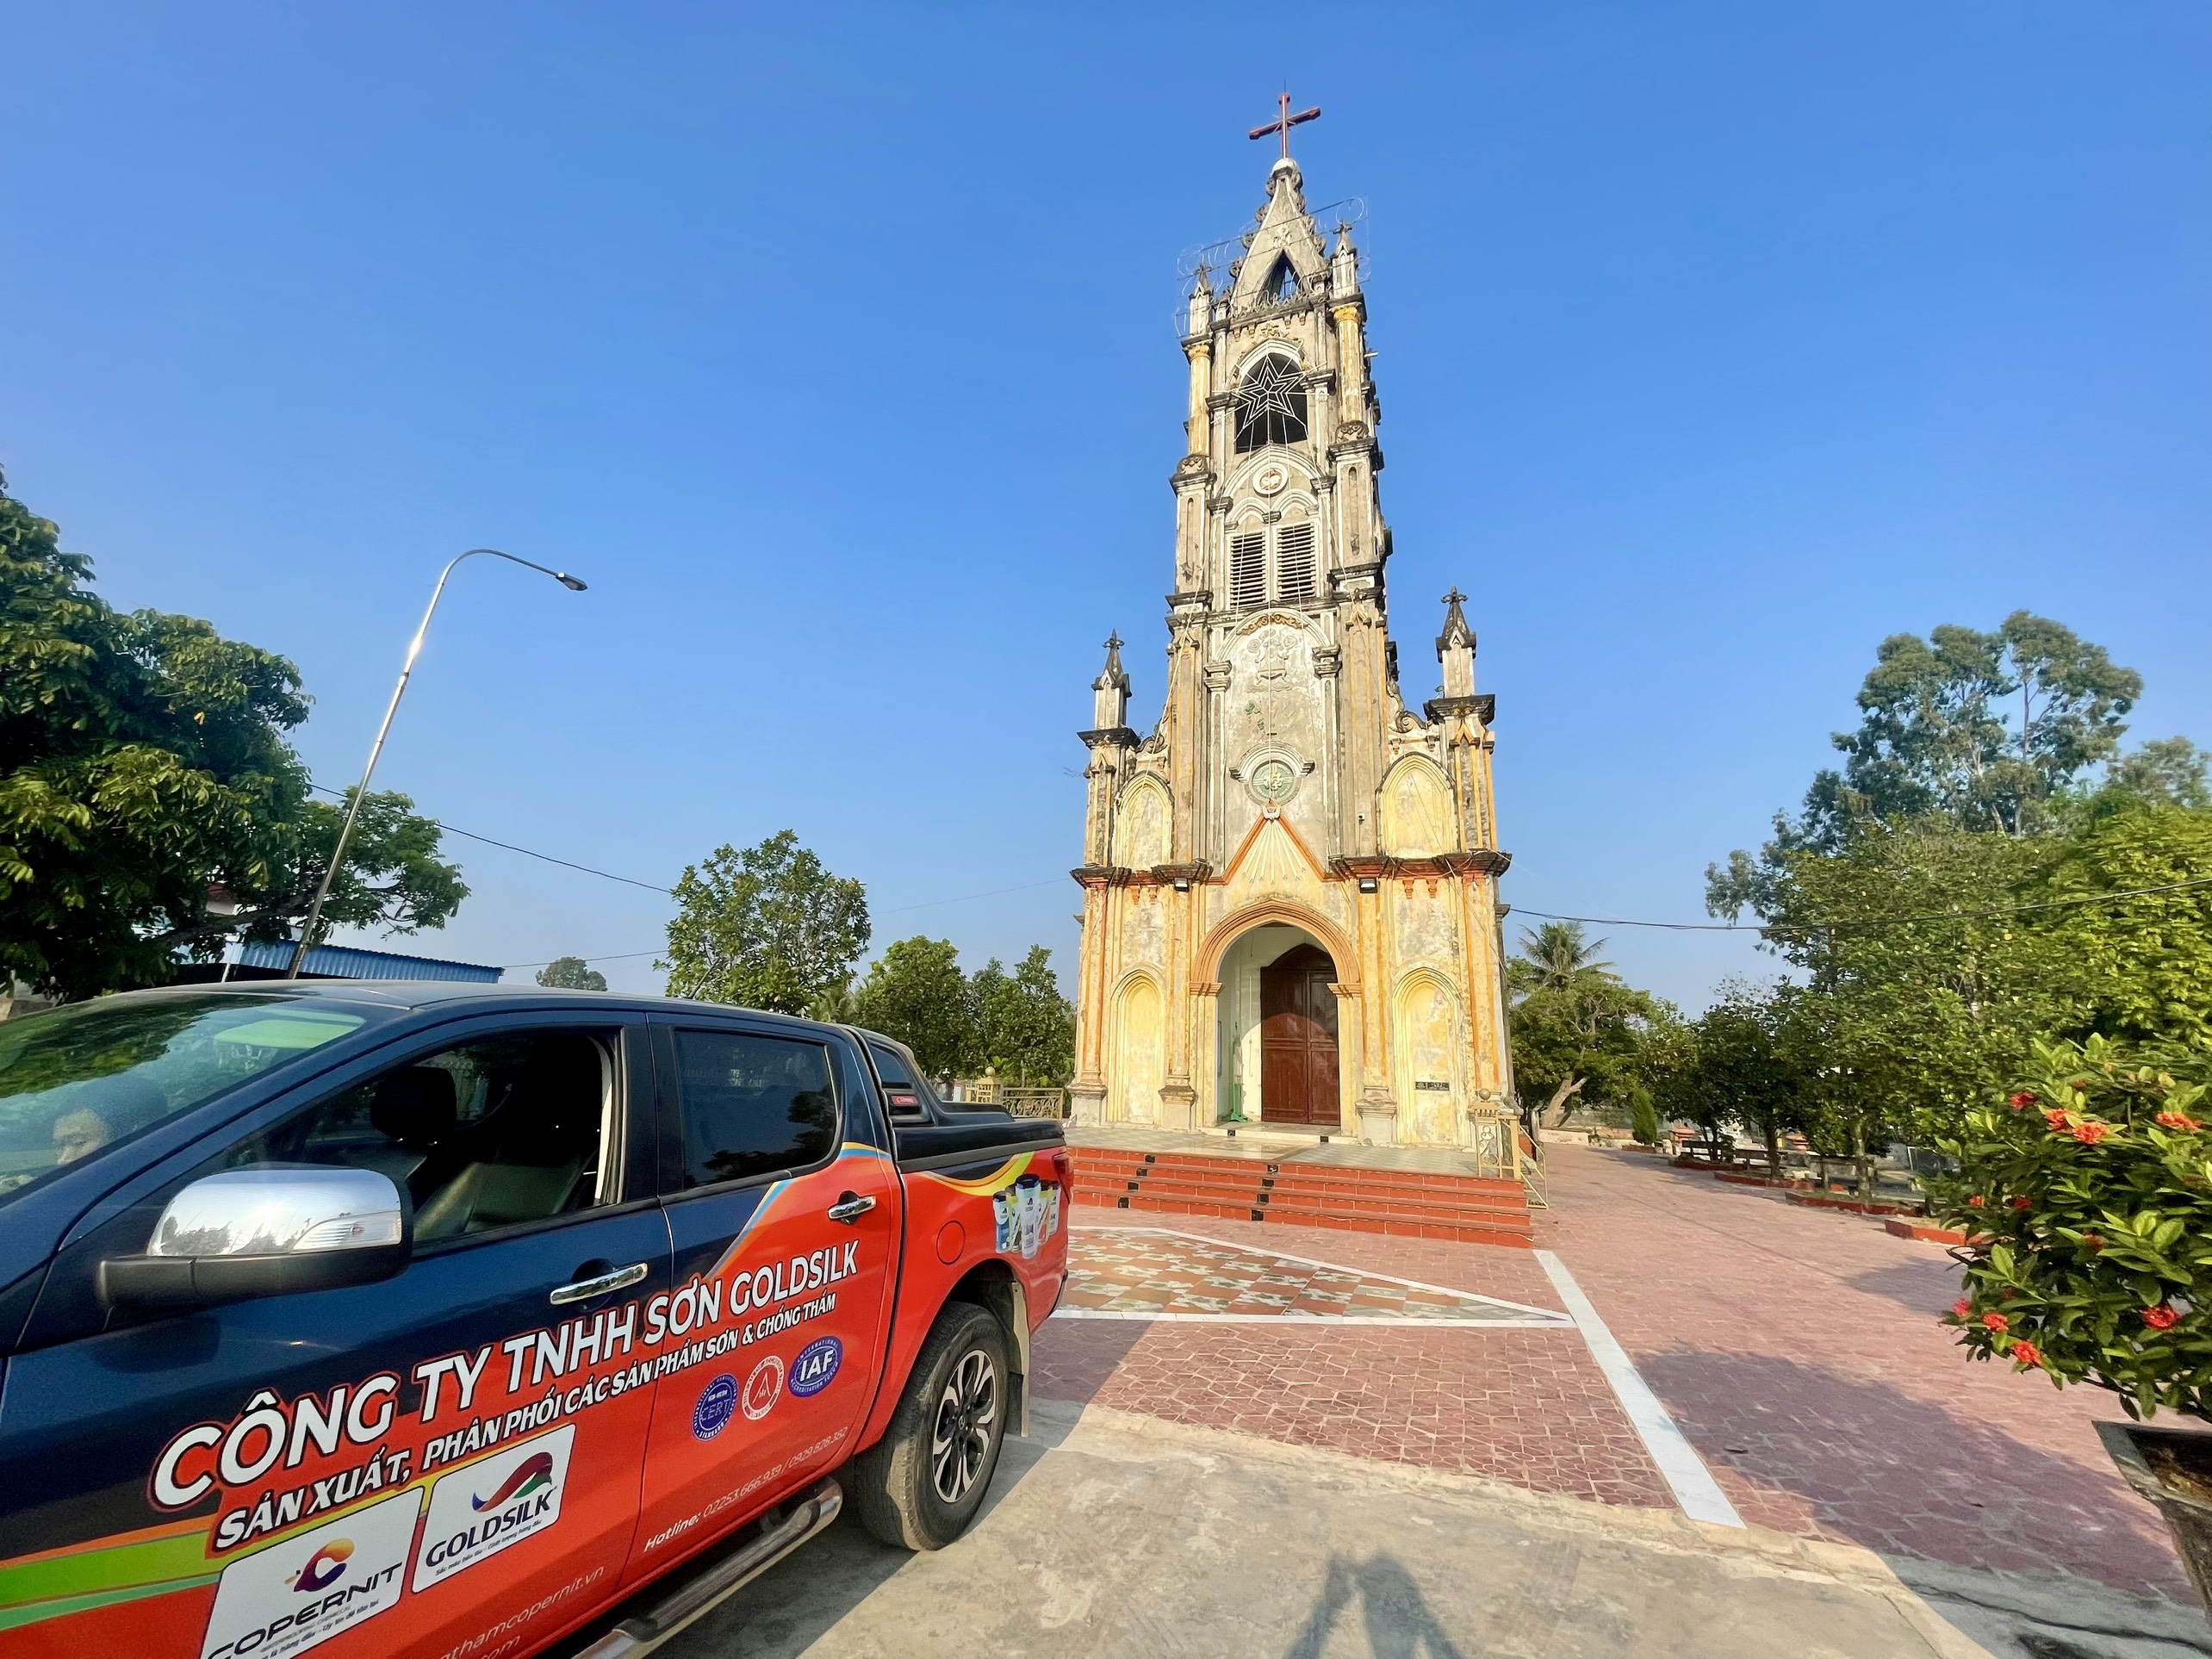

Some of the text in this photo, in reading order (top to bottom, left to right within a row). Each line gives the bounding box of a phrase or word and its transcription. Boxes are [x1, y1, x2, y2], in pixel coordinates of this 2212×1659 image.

[155, 1240, 860, 1506] CÔNG TY TNHH SƠN GOLDSILK
[800, 1349, 835, 1382] IAF
[215, 1290, 836, 1548] SẢN XUẤT, PHÂN PHỐI CÁC SẢN PHẨM SƠN & CHỐNG THẤM
[426, 1489, 554, 1568] GOLDSILK
[644, 1512, 700, 1552] Hotline:
[208, 1562, 403, 1659] COPERNIT
[482, 1635, 521, 1659] om
